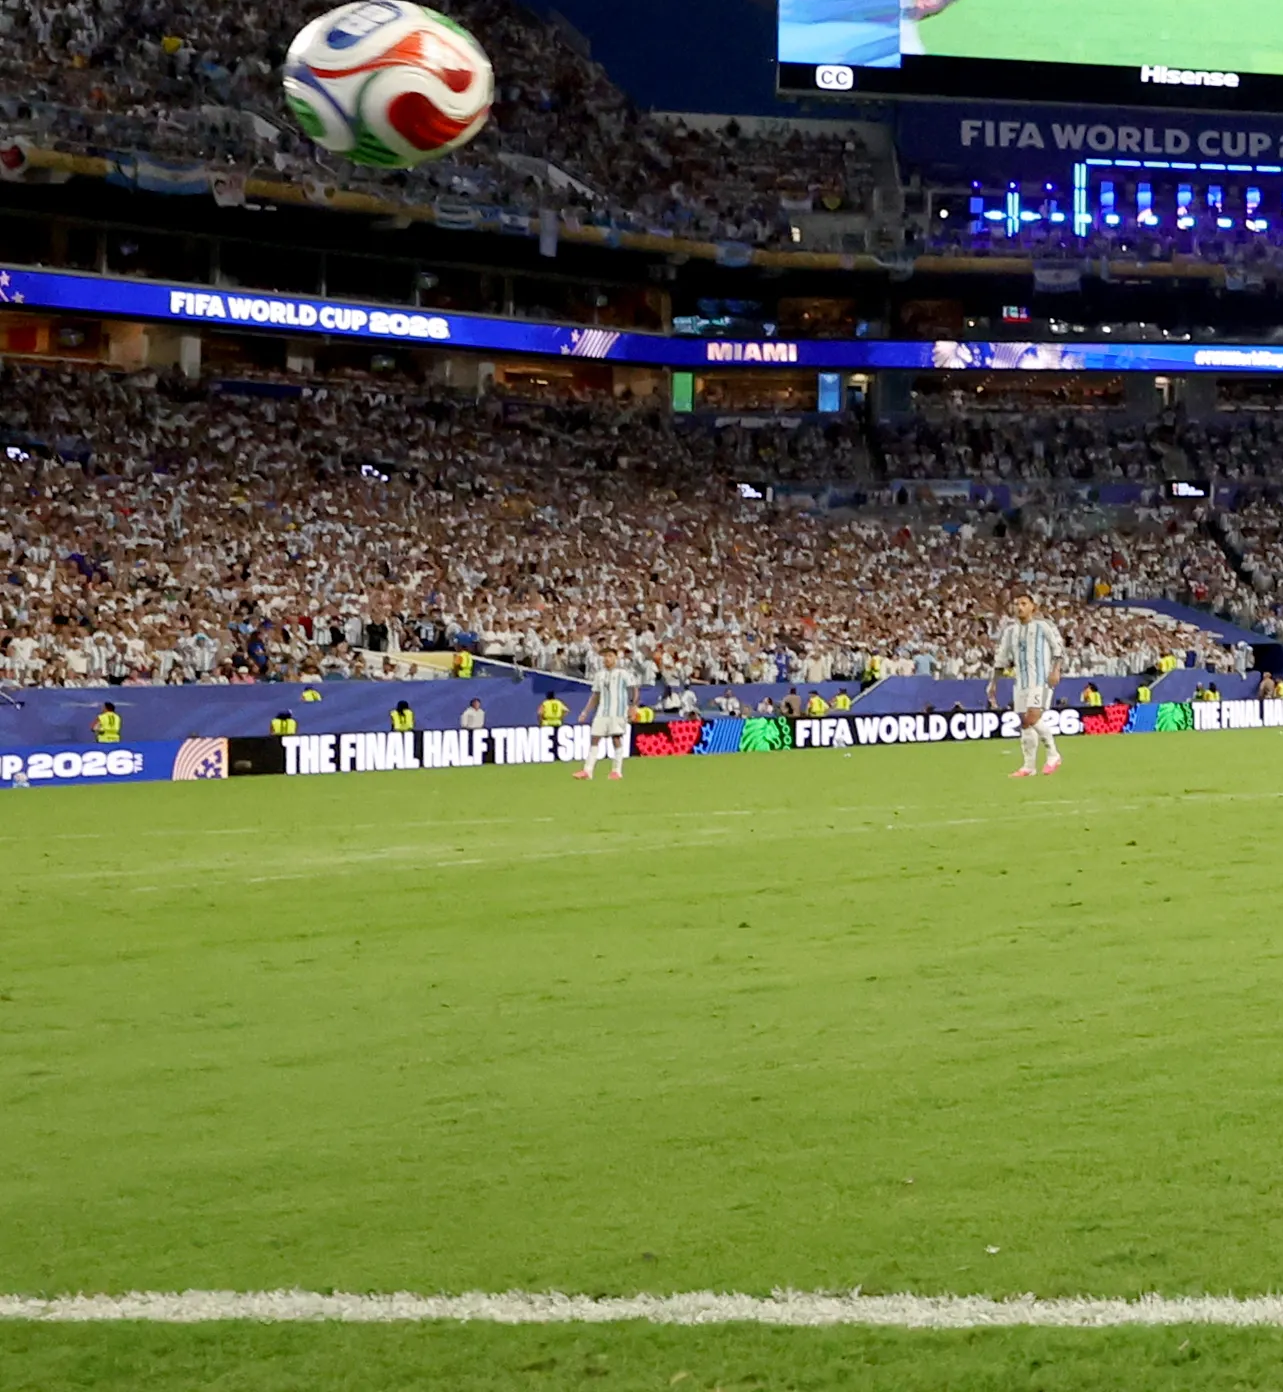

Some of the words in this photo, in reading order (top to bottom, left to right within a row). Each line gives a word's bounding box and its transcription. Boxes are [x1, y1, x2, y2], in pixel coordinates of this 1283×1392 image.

[820, 70, 850, 87] CC
[1140, 64, 1240, 91] Hisense
[961, 120, 1045, 149] FIFA
[1052, 123, 1190, 156] WORLD
[1198, 130, 1272, 157] CUP
[170, 291, 226, 319] FIFA
[227, 296, 317, 327] WORLD
[319, 306, 368, 331] CUP
[368, 311, 450, 339] 2026
[707, 342, 798, 362] MIAMI
[795, 717, 853, 747] FIFA
[855, 714, 948, 745] WORLD
[950, 712, 999, 740] CUP
[1001, 709, 1080, 737] 226
[1192, 701, 1221, 730] THE
[1221, 699, 1263, 728] FINAL
[27, 750, 133, 780] 2026
[282, 735, 337, 775] THE
[340, 731, 419, 773] FINAL
[422, 729, 489, 768] HALF
[490, 726, 556, 765] TIME
[557, 724, 631, 762] SH
